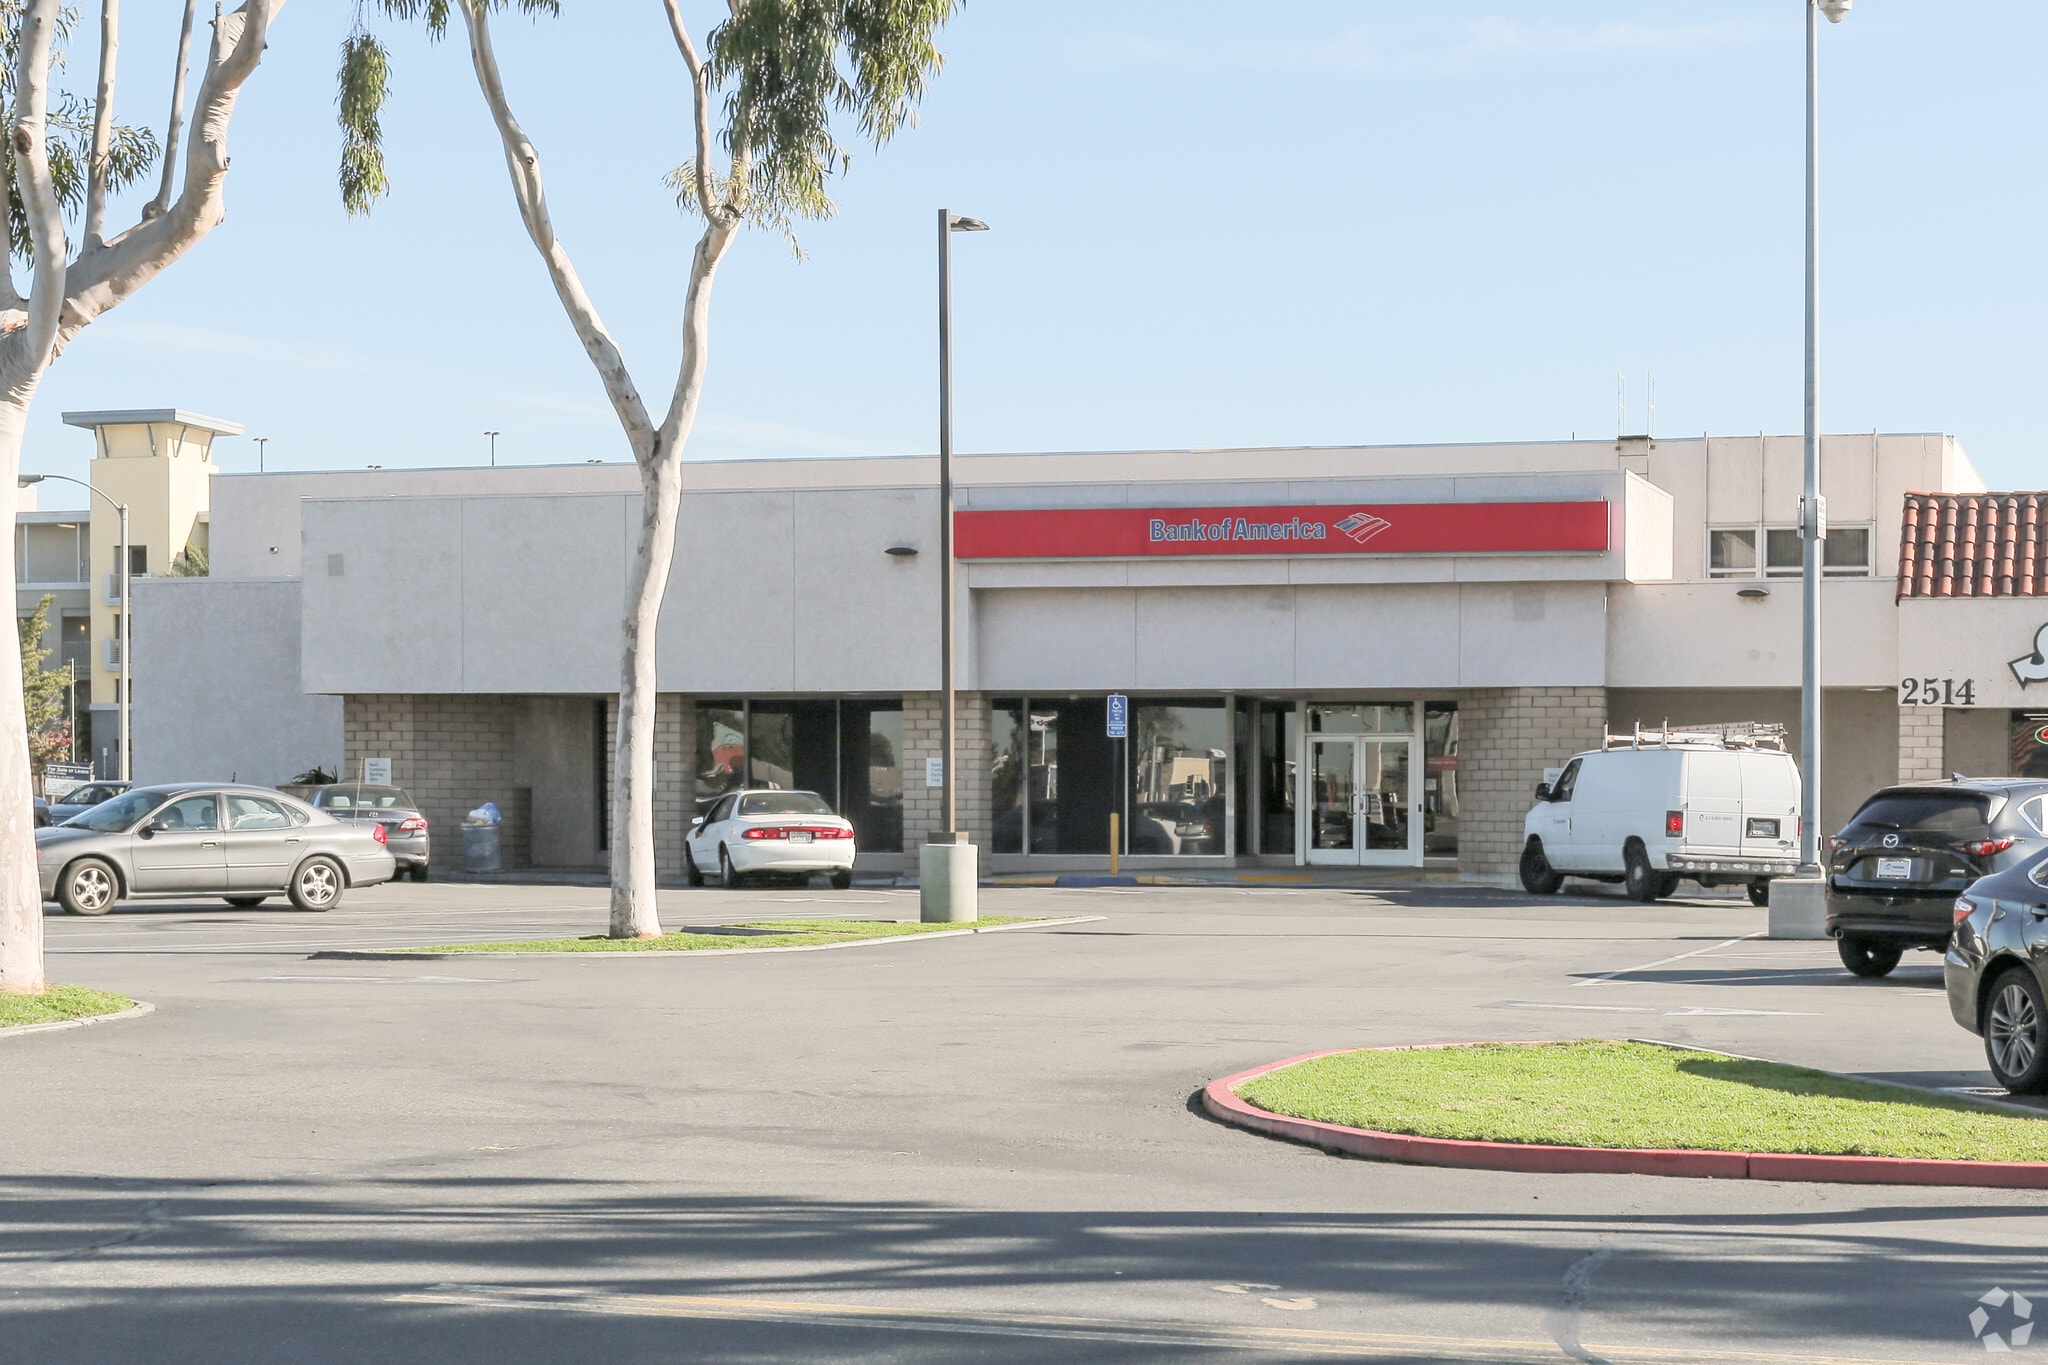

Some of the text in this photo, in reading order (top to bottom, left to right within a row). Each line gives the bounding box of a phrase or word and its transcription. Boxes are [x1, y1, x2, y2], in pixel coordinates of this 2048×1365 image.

[1150, 517, 1326, 541] Bank of America
[1901, 677, 1976, 706] 2514
